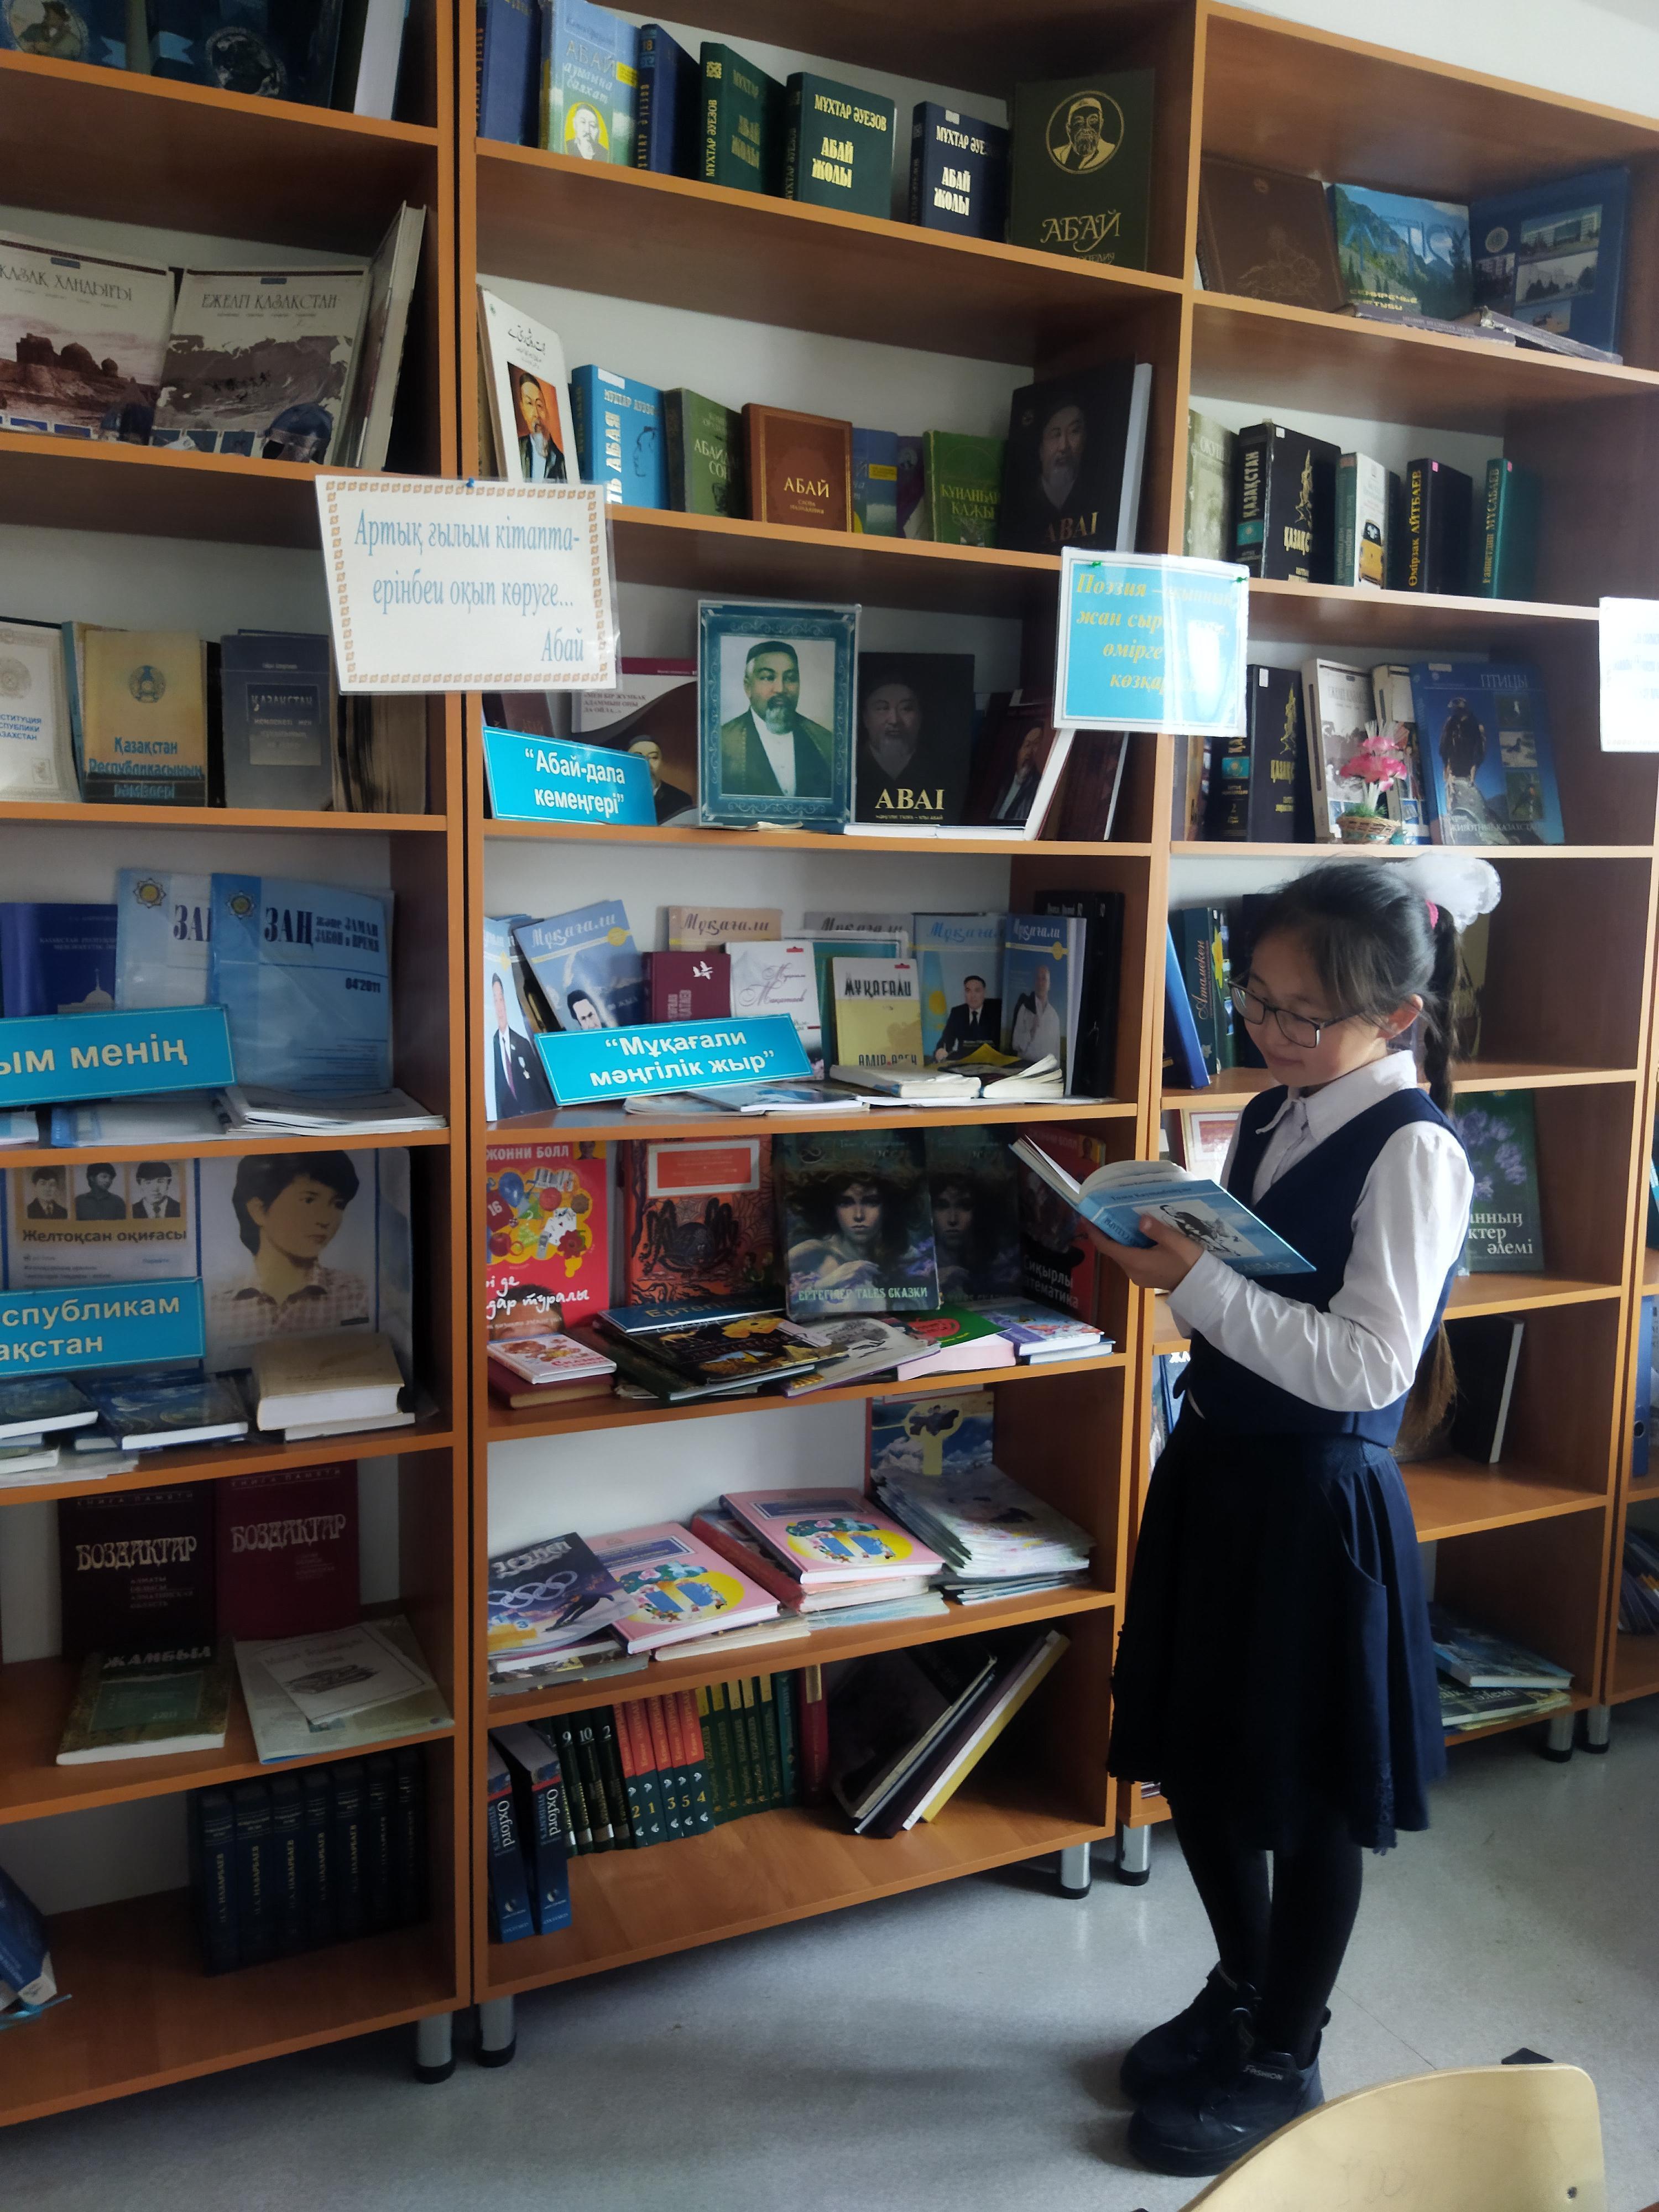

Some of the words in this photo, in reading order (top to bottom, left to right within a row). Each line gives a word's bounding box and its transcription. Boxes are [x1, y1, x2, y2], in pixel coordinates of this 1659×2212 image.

[815, 94, 852, 119] МҰХТАР
[853, 107, 888, 132] ӘУЕЗОВ
[821, 137, 854, 165] АБАЙ
[811, 158, 853, 189] ЖОЛЫ
[942, 167, 971, 193] АБАЙ
[933, 187, 970, 217] ЖОЛЫ
[1040, 208, 1121, 252] АБАЙ
[604, 411, 622, 473] АБАЯ
[784, 476, 830, 498] АБАЙ
[354, 509, 423, 556] Артық
[1077, 573, 1146, 596] Поэзия
[450, 580, 495, 614] оқып
[1076, 611, 1121, 626] жан
[540, 627, 585, 662] Абай
[1480, 673, 1528, 690] ПТИЦЫ
[114, 736, 178, 758] Қазақстан
[874, 787, 947, 810] ABAI
[264, 906, 314, 952] ЗАҢ
[70, 1032, 189, 1071] менің
[589, 1061, 701, 1088] мәңгілік
[486, 1146, 533, 1161] ЖОННИ
[536, 1145, 570, 1159] БОЛЛ
[22, 1229, 112, 1245] Желтоқсан
[116, 1230, 187, 1244] оқиғасы
[1487, 1238, 1533, 1254] әлемі
[1023, 1254, 1074, 1289] Сиқырлы
[856, 1287, 886, 1299] TALES
[888, 1286, 928, 1298] СКАЗКИ
[562, 1730, 572, 1743] 9
[579, 1726, 593, 1742] 10
[602, 1725, 611, 1739] 2
[649, 1802, 656, 1814] 1
[667, 1797, 677, 1810] 3
[681, 1794, 690, 1808] 5
[697, 1791, 707, 1803] 4
[497, 1799, 516, 1848] Oxford
[546, 1788, 562, 1837] Oxford
[632, 1805, 641, 1819] 2
